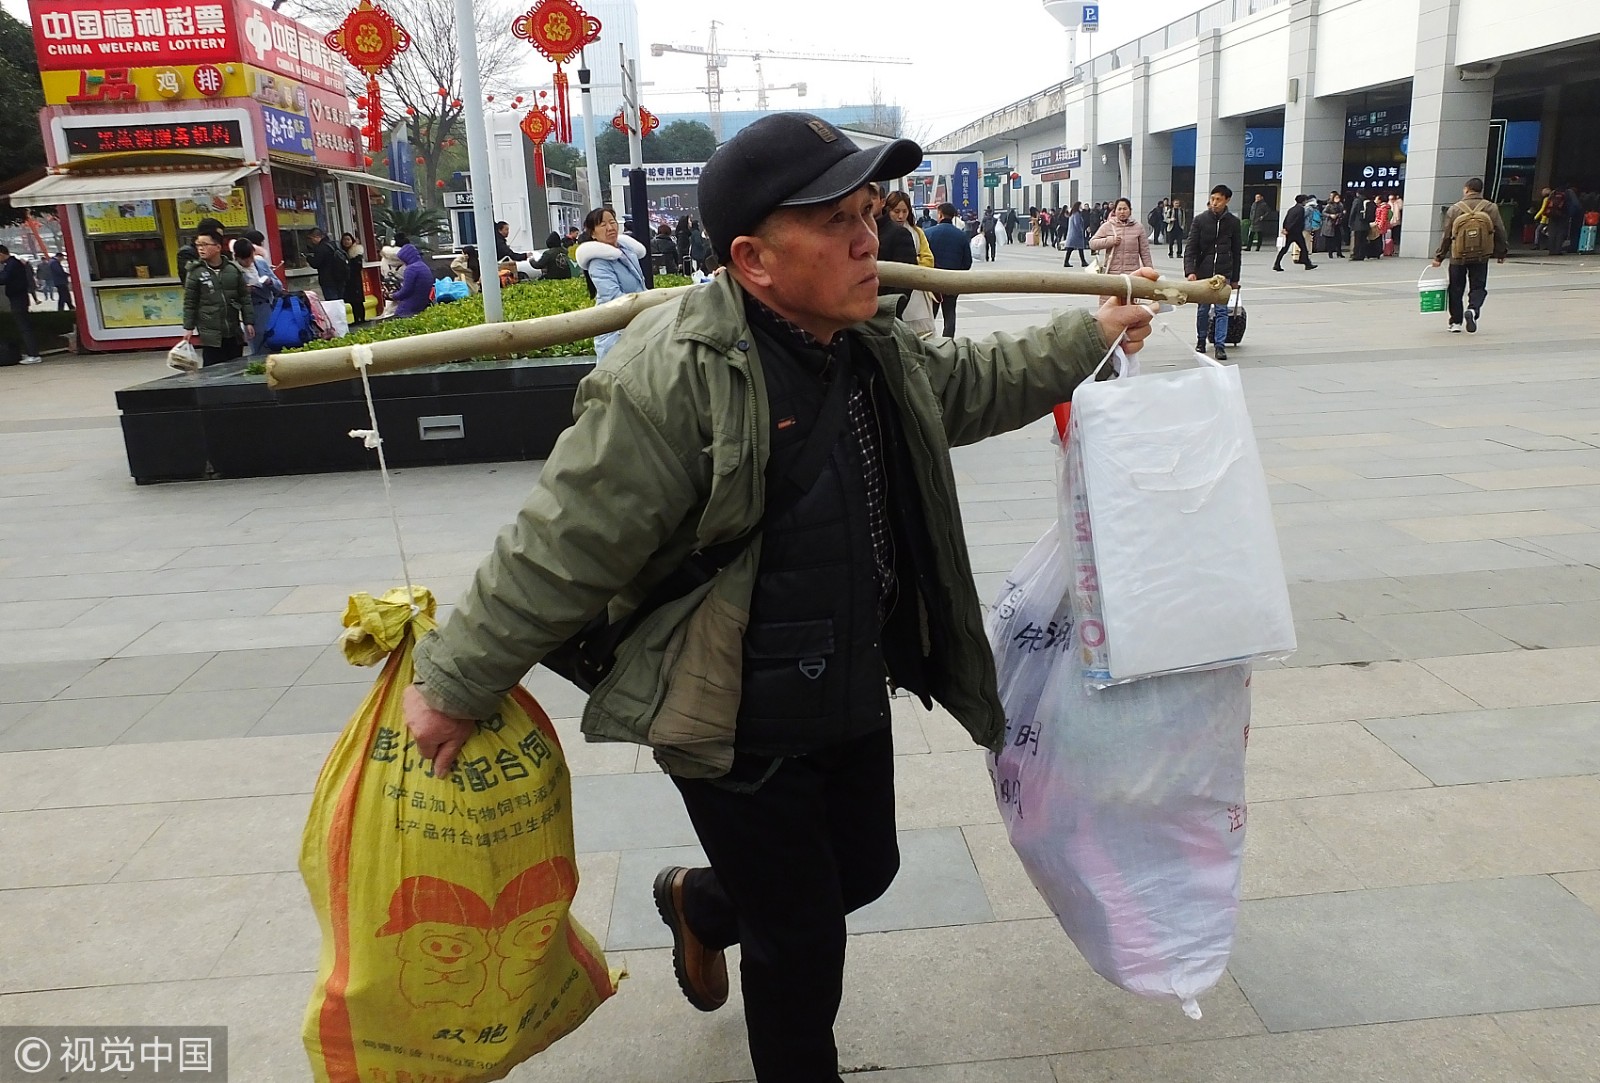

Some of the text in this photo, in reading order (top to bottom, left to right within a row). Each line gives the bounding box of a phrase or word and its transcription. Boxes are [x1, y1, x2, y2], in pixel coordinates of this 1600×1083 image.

[41, 4, 226, 40] 中国福利彩票
[47, 38, 226, 55] CHINA WELFARE LOTTERY
